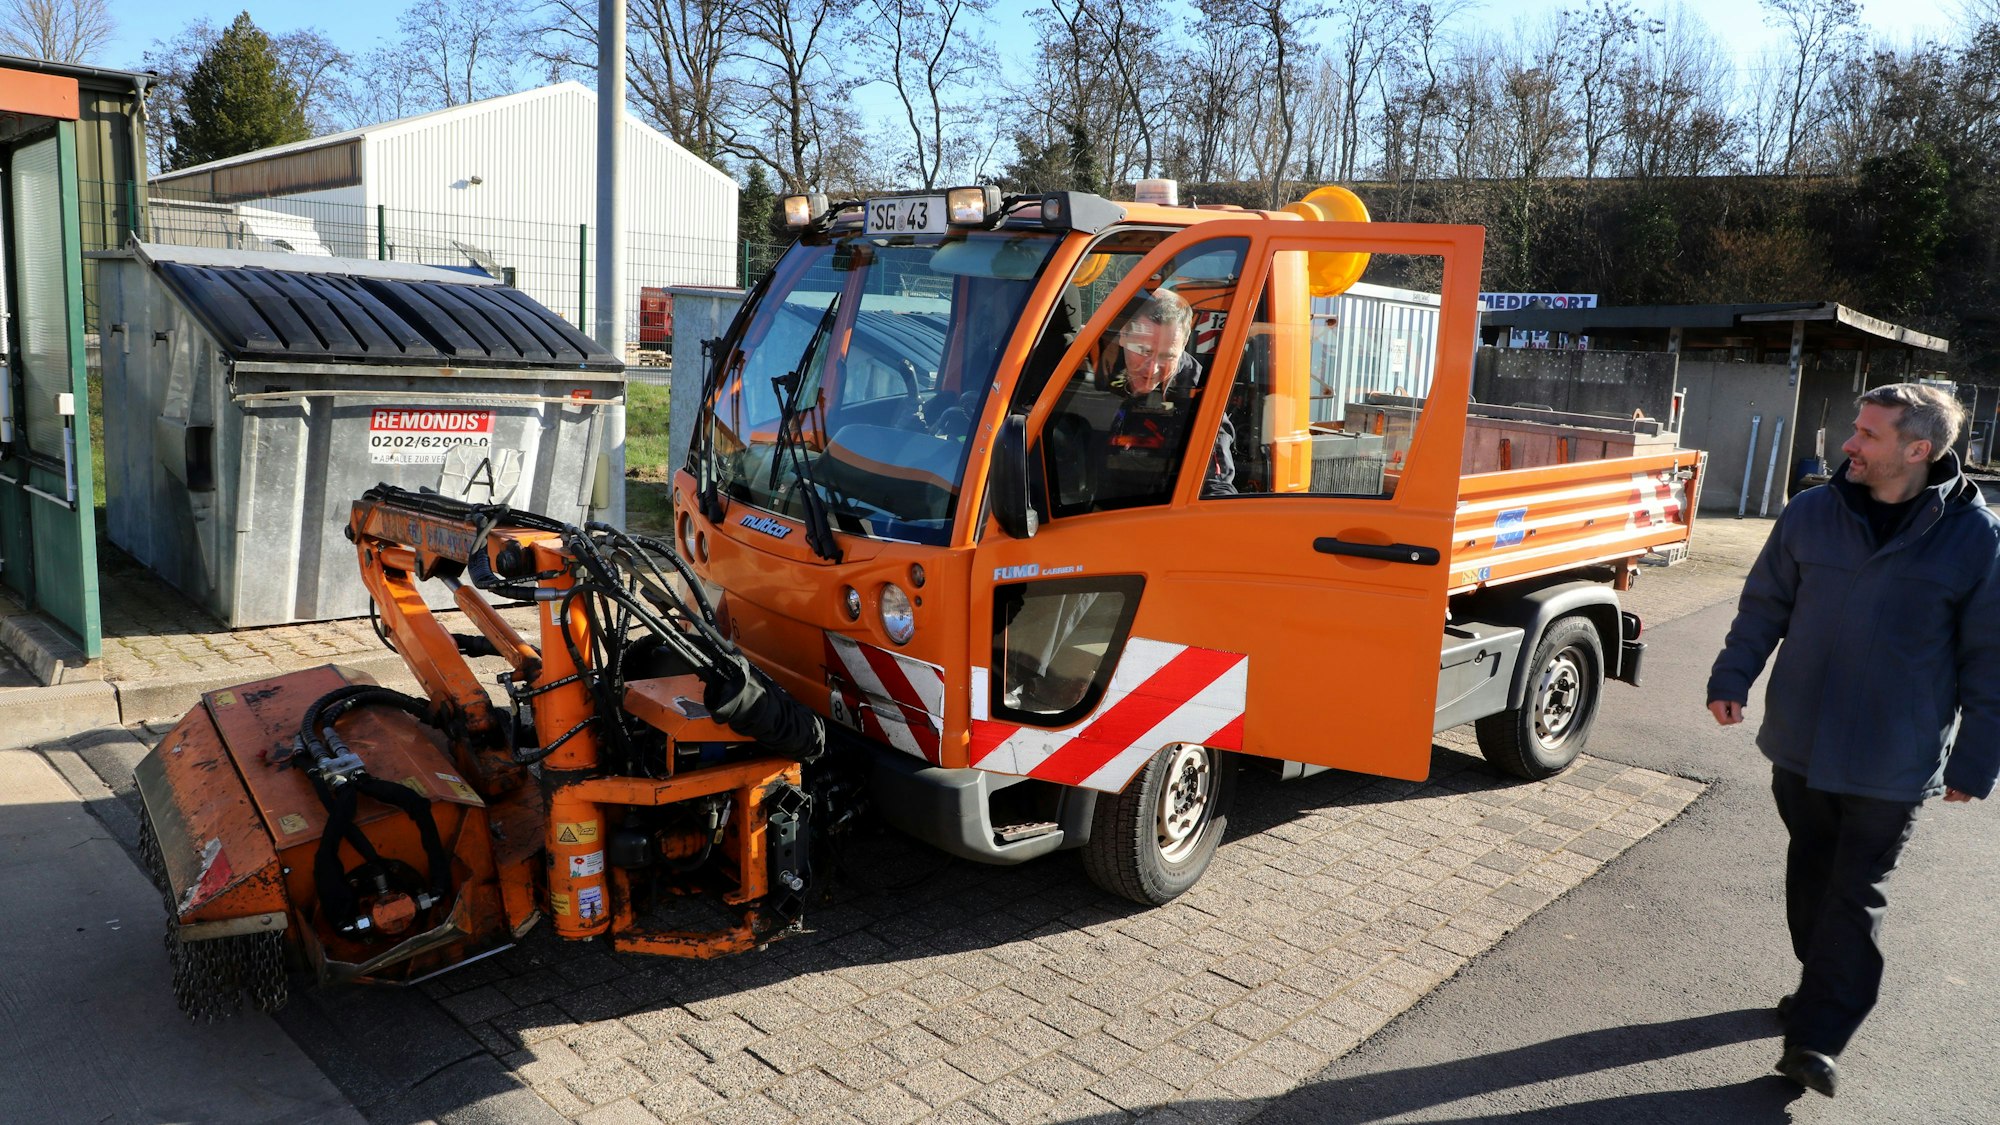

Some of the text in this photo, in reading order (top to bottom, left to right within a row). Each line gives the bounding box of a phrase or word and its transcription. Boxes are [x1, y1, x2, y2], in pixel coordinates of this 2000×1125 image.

[875, 202, 928, 230] SG 43
[739, 514, 793, 539] multicar
[993, 563, 1039, 581] FUMO
[1042, 566, 1075, 576] CARRIER
